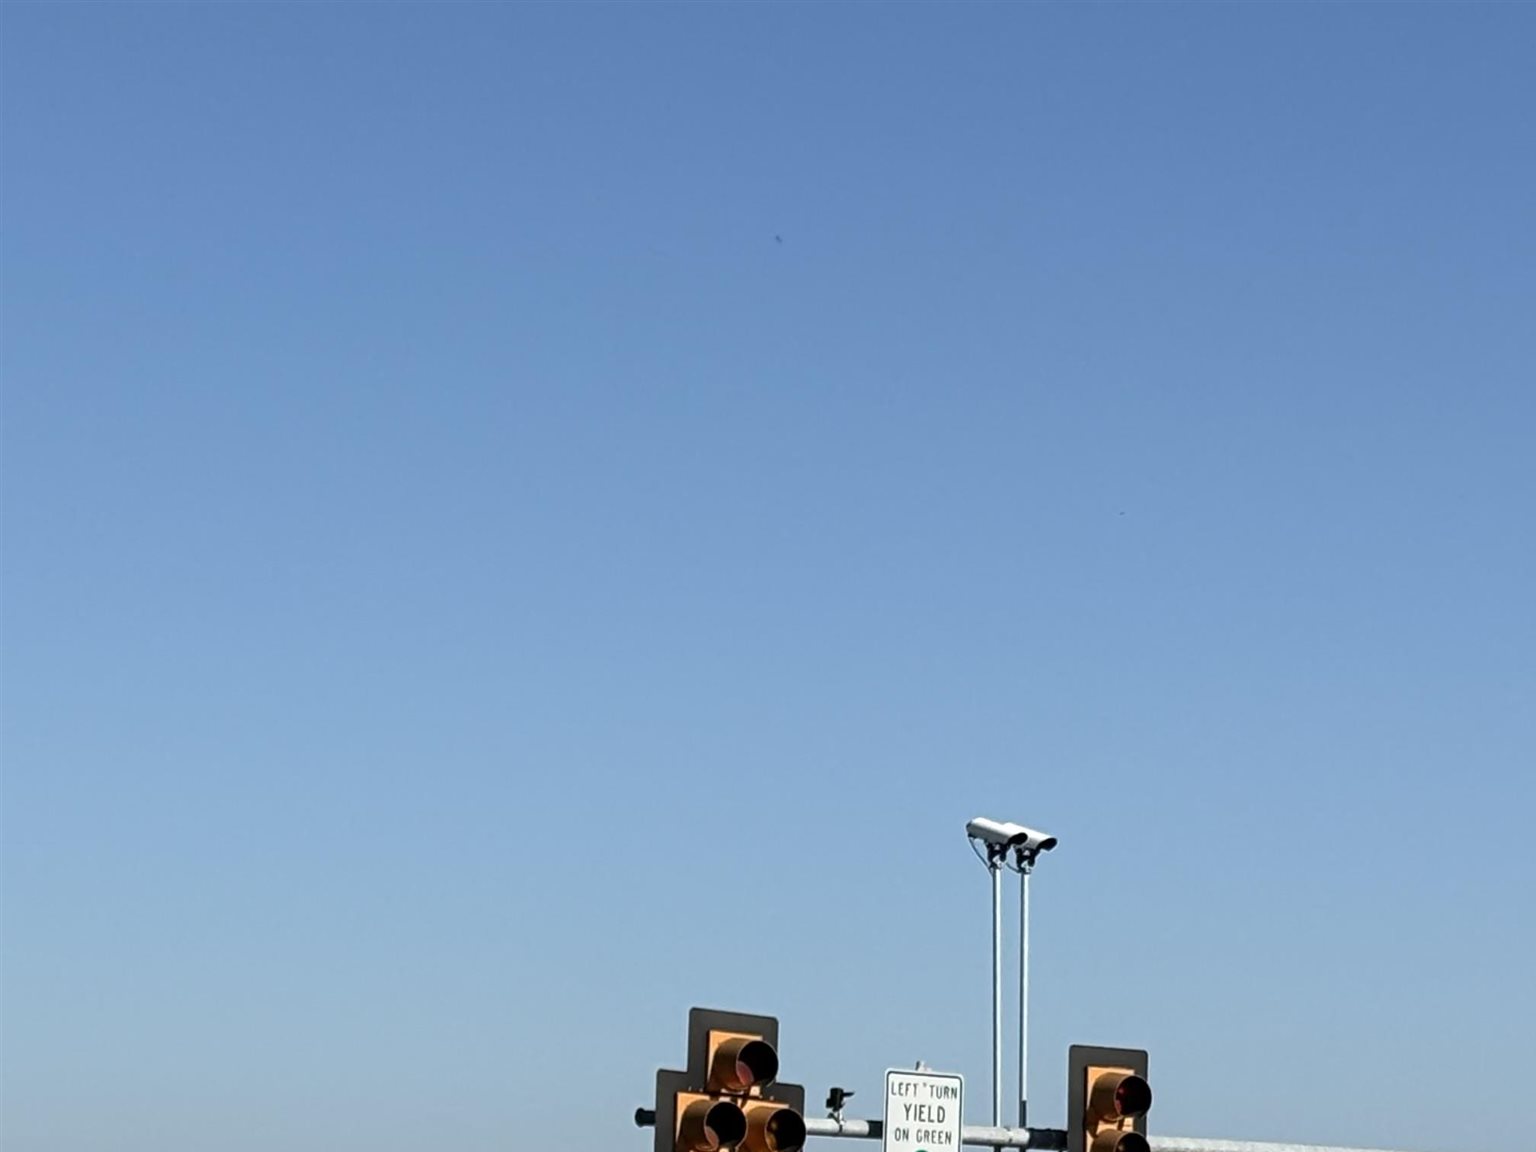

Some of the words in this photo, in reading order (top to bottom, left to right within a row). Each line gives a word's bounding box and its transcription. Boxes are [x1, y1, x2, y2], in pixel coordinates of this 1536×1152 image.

[891, 1081, 918, 1097] LEFT
[929, 1084, 958, 1100] TURN
[903, 1103, 946, 1123] YIELD
[894, 1127, 910, 1142] ON
[915, 1128, 952, 1145] GREEN
